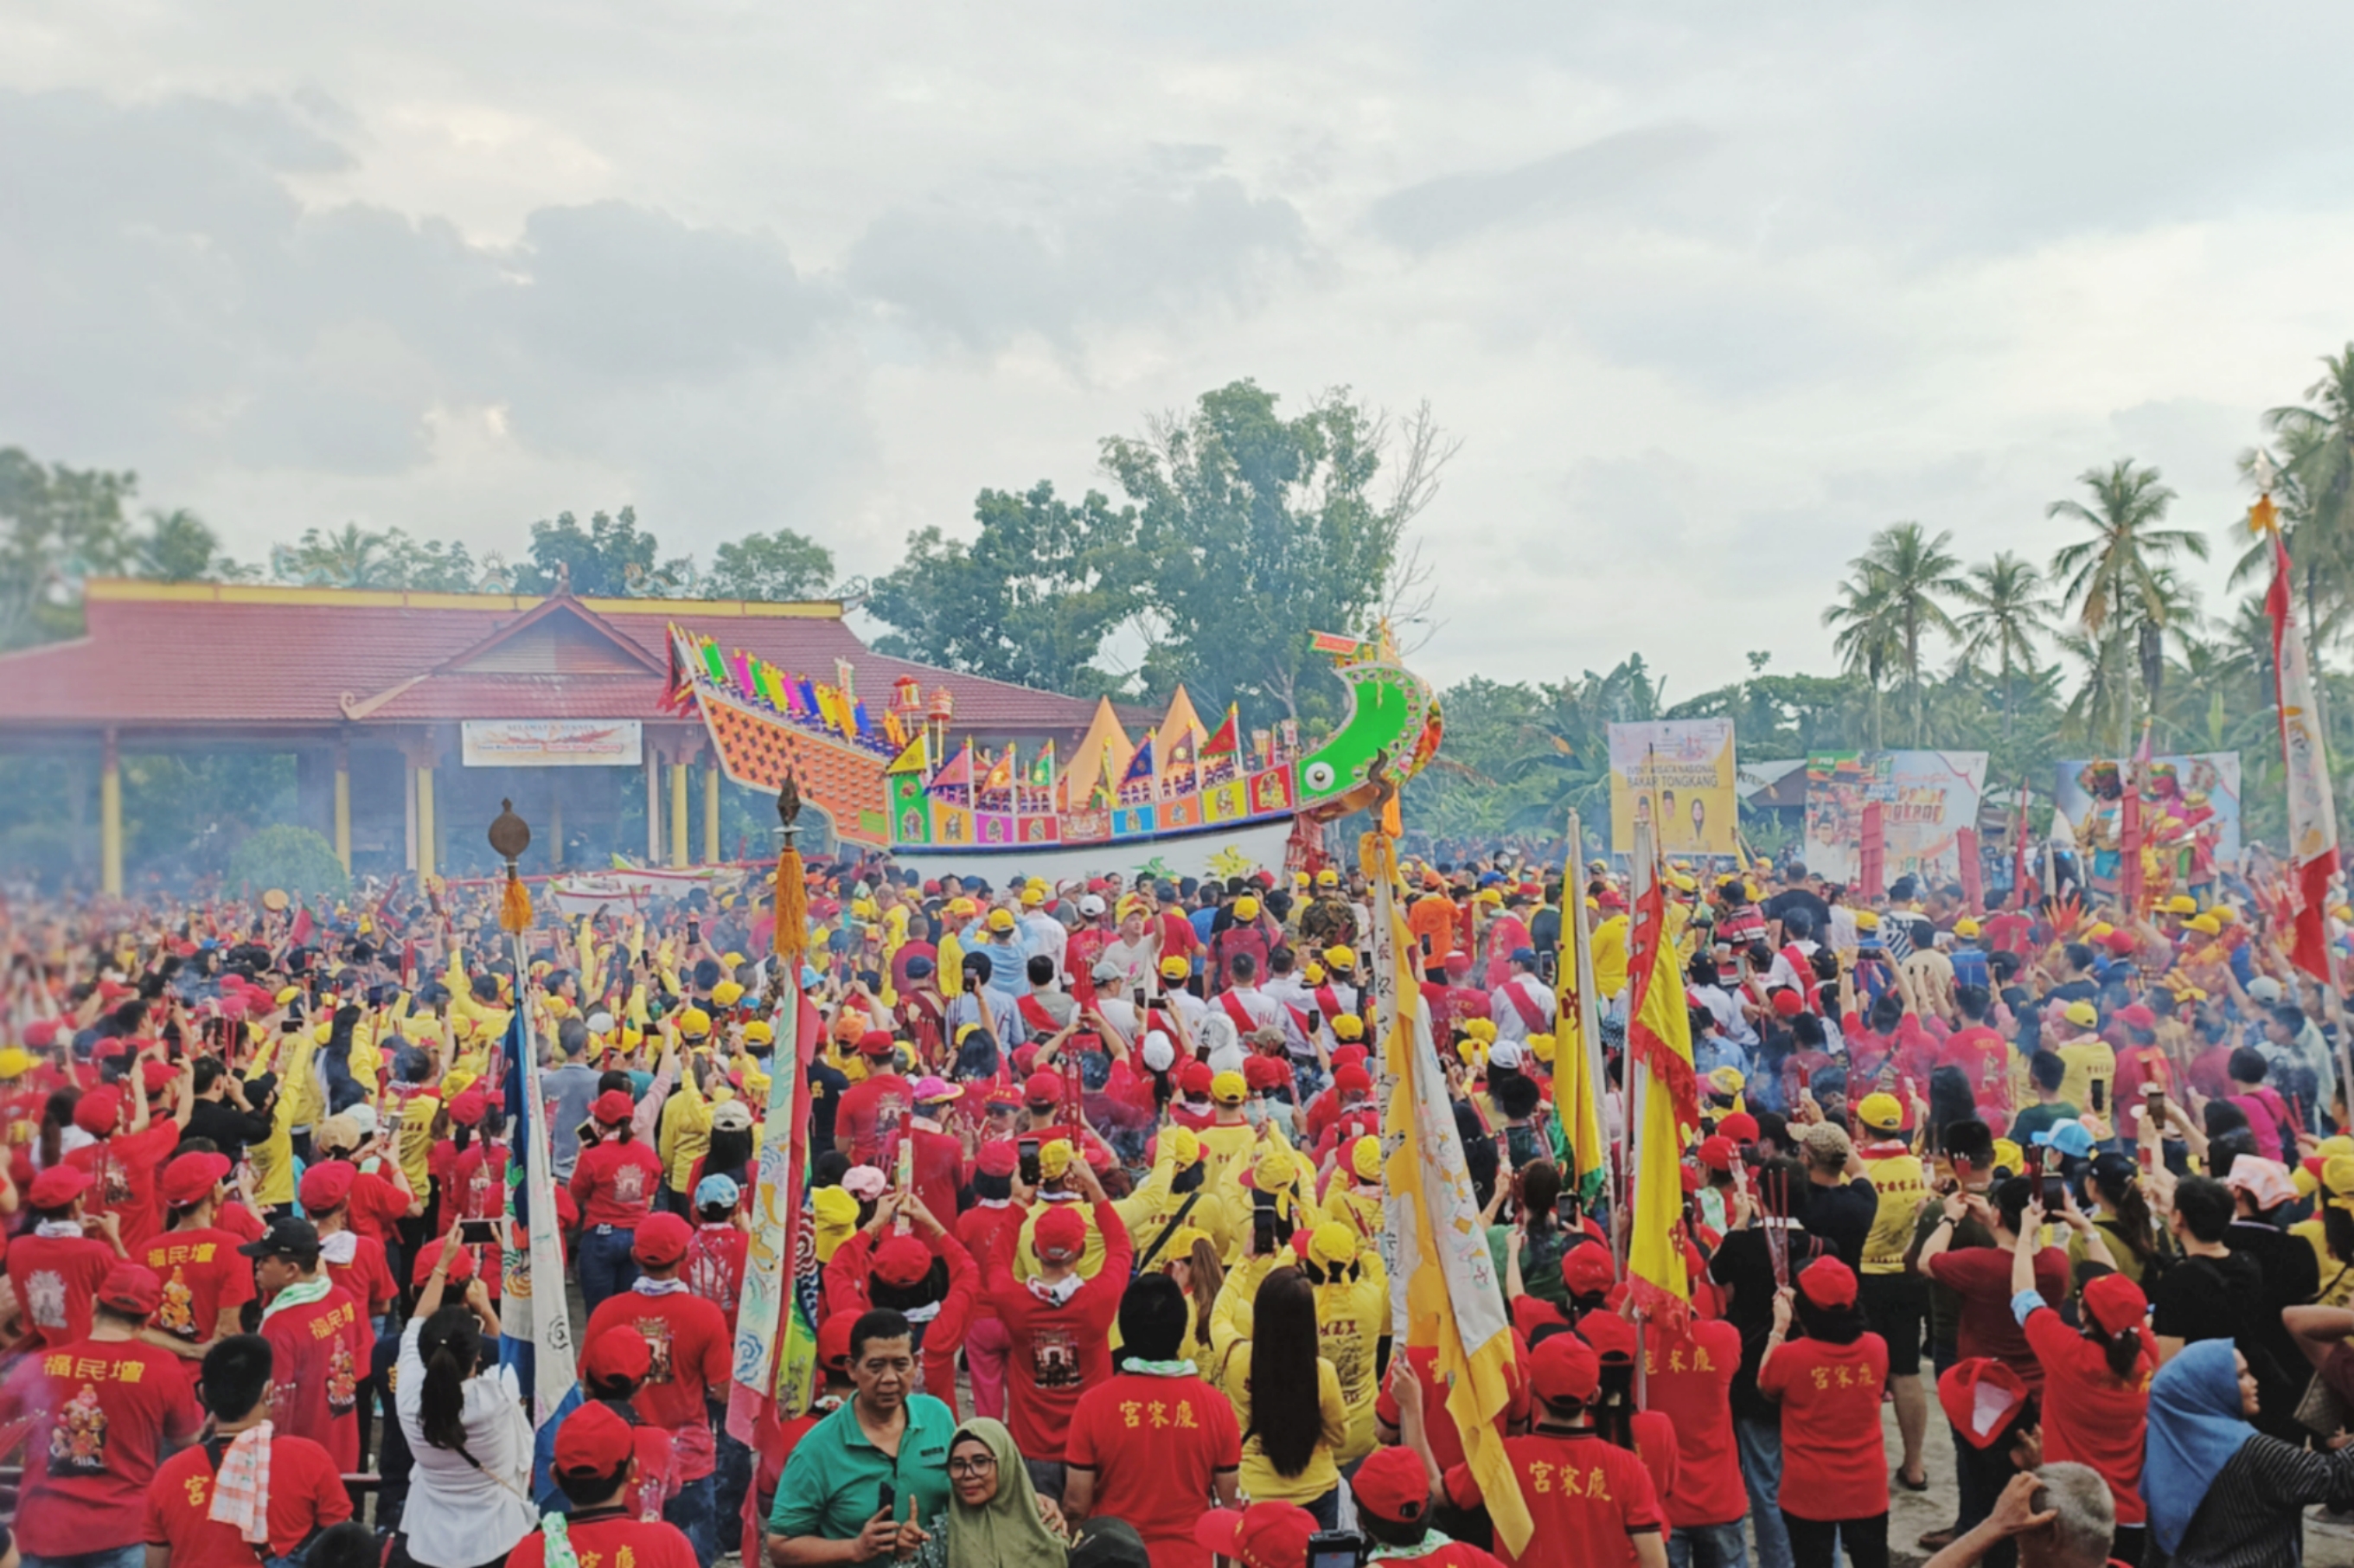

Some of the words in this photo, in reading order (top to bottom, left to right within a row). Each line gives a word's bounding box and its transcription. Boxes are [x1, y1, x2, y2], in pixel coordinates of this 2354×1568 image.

[1677, 764, 1718, 774] NASIONAL
[1627, 777, 1659, 789] BAKAR
[1662, 775, 1718, 788] TONGKANG
[44, 1354, 145, 1383] 福民壇
[184, 1474, 210, 1507] 宮
